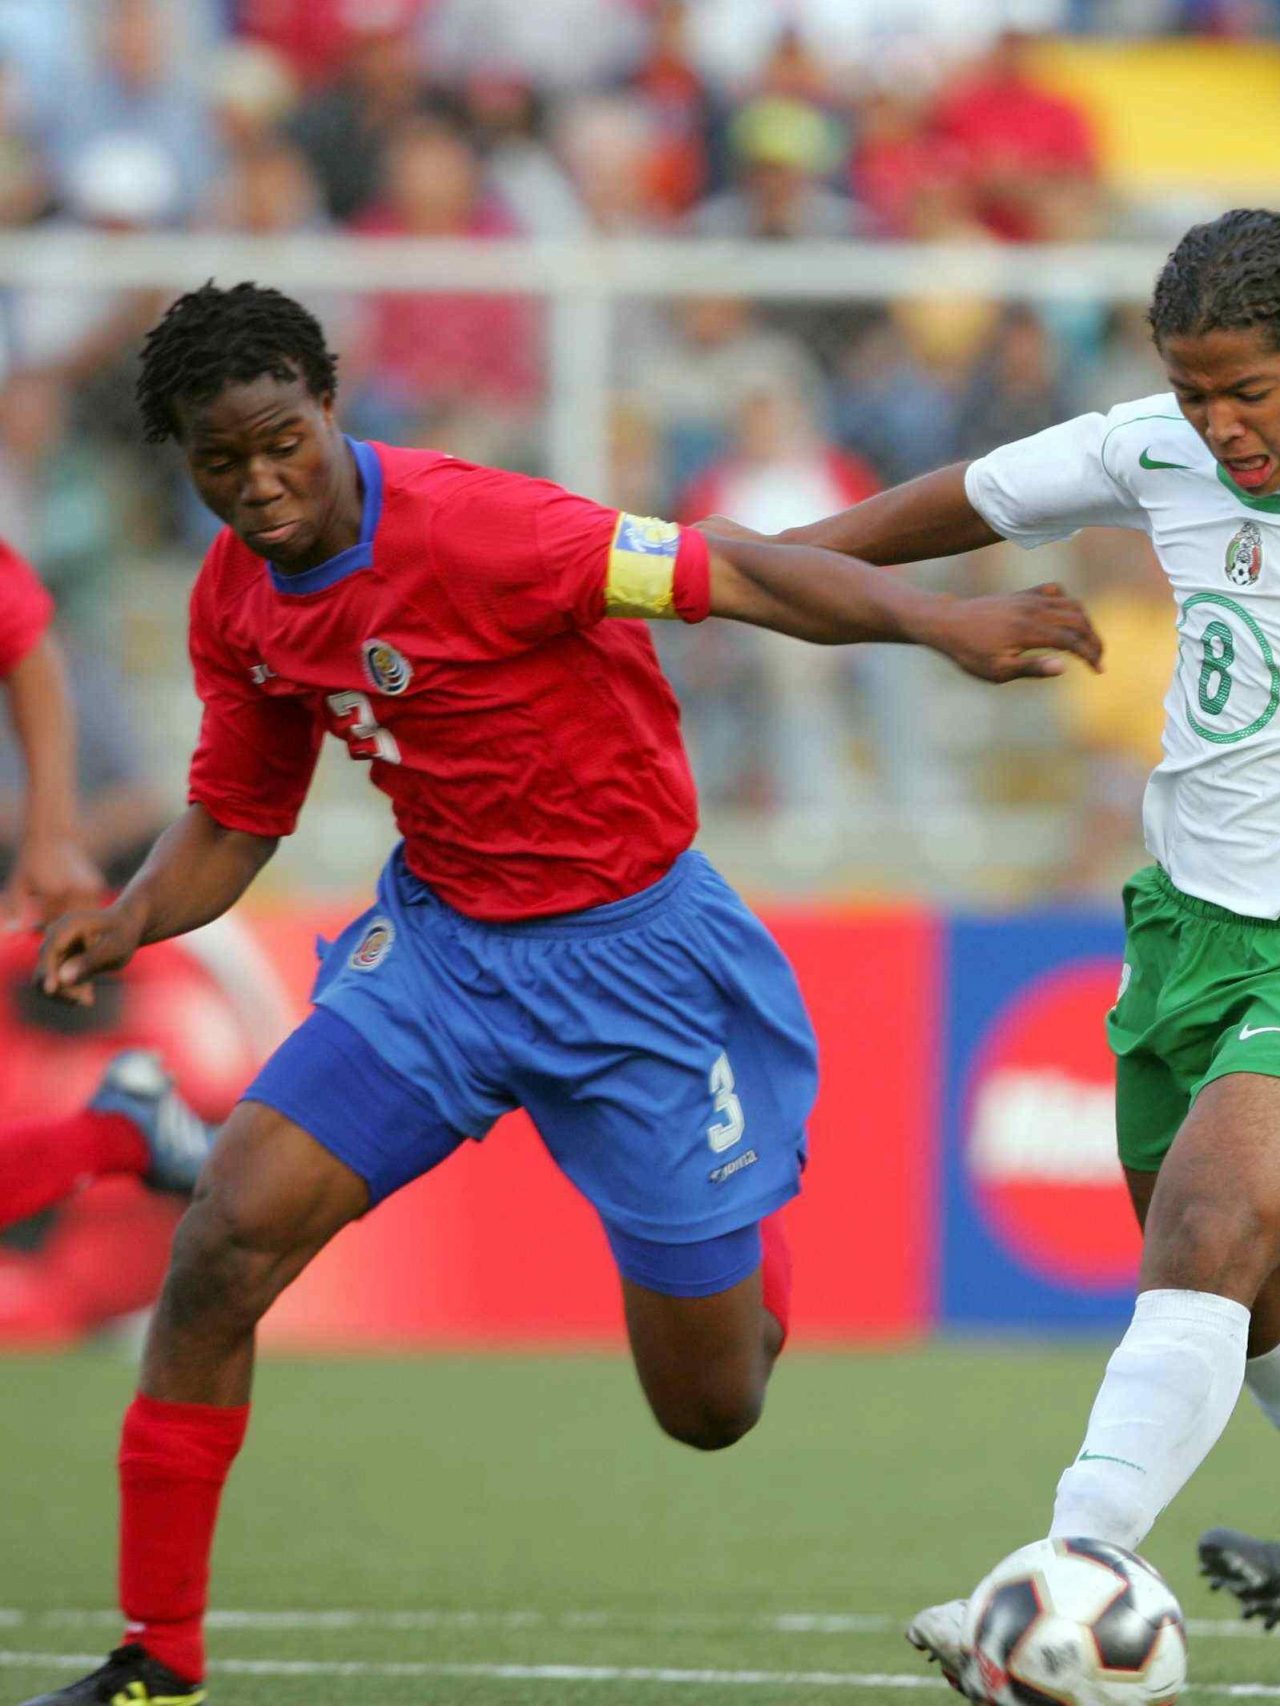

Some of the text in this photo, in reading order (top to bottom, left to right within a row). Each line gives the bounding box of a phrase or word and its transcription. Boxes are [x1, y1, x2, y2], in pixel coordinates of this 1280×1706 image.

[1199, 621, 1235, 715] 8
[327, 690, 402, 764] 3
[707, 1051, 746, 1153] 3
